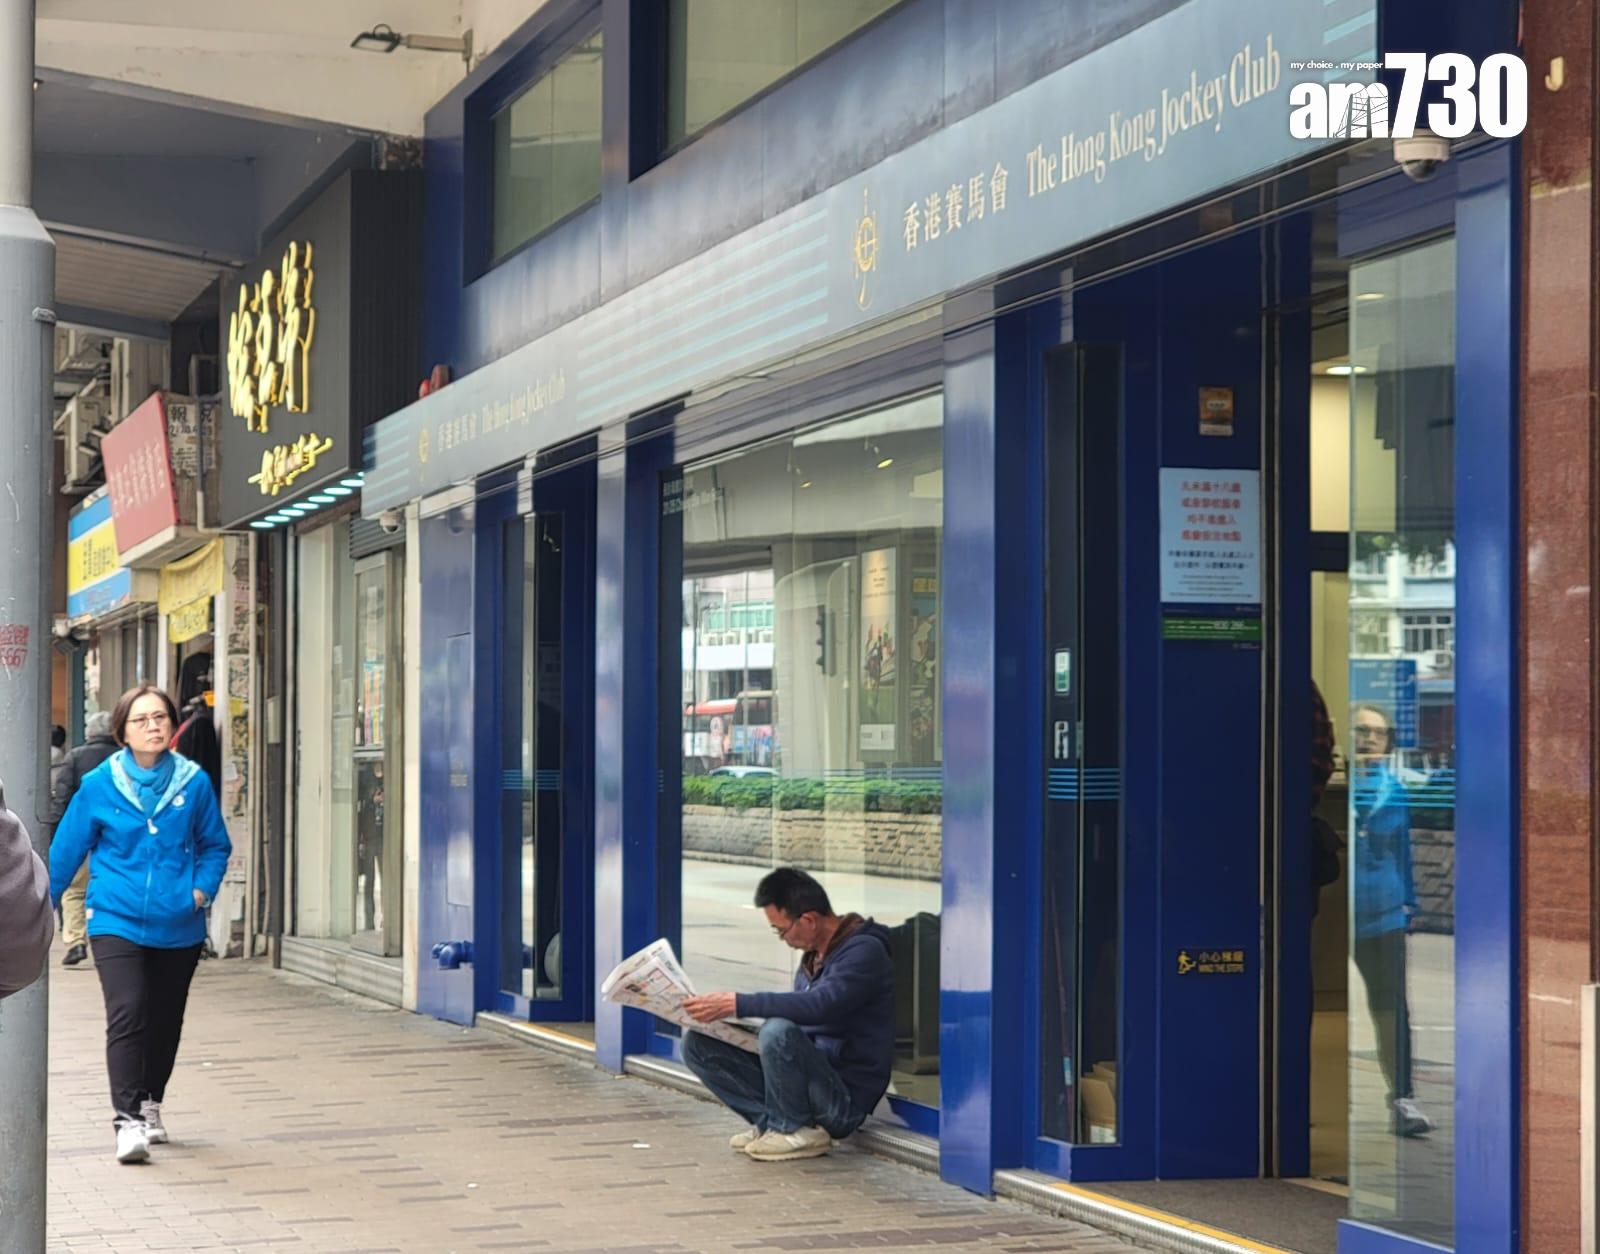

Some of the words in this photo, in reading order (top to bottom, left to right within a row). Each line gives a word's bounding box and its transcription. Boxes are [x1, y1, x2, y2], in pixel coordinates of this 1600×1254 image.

[1026, 143, 1057, 197] The
[1061, 132, 1105, 183] Hong
[1109, 110, 1157, 161] Kong
[1157, 70, 1226, 154] Jockey
[1229, 33, 1281, 107] Club
[903, 162, 1009, 251] 香港賽馬會
